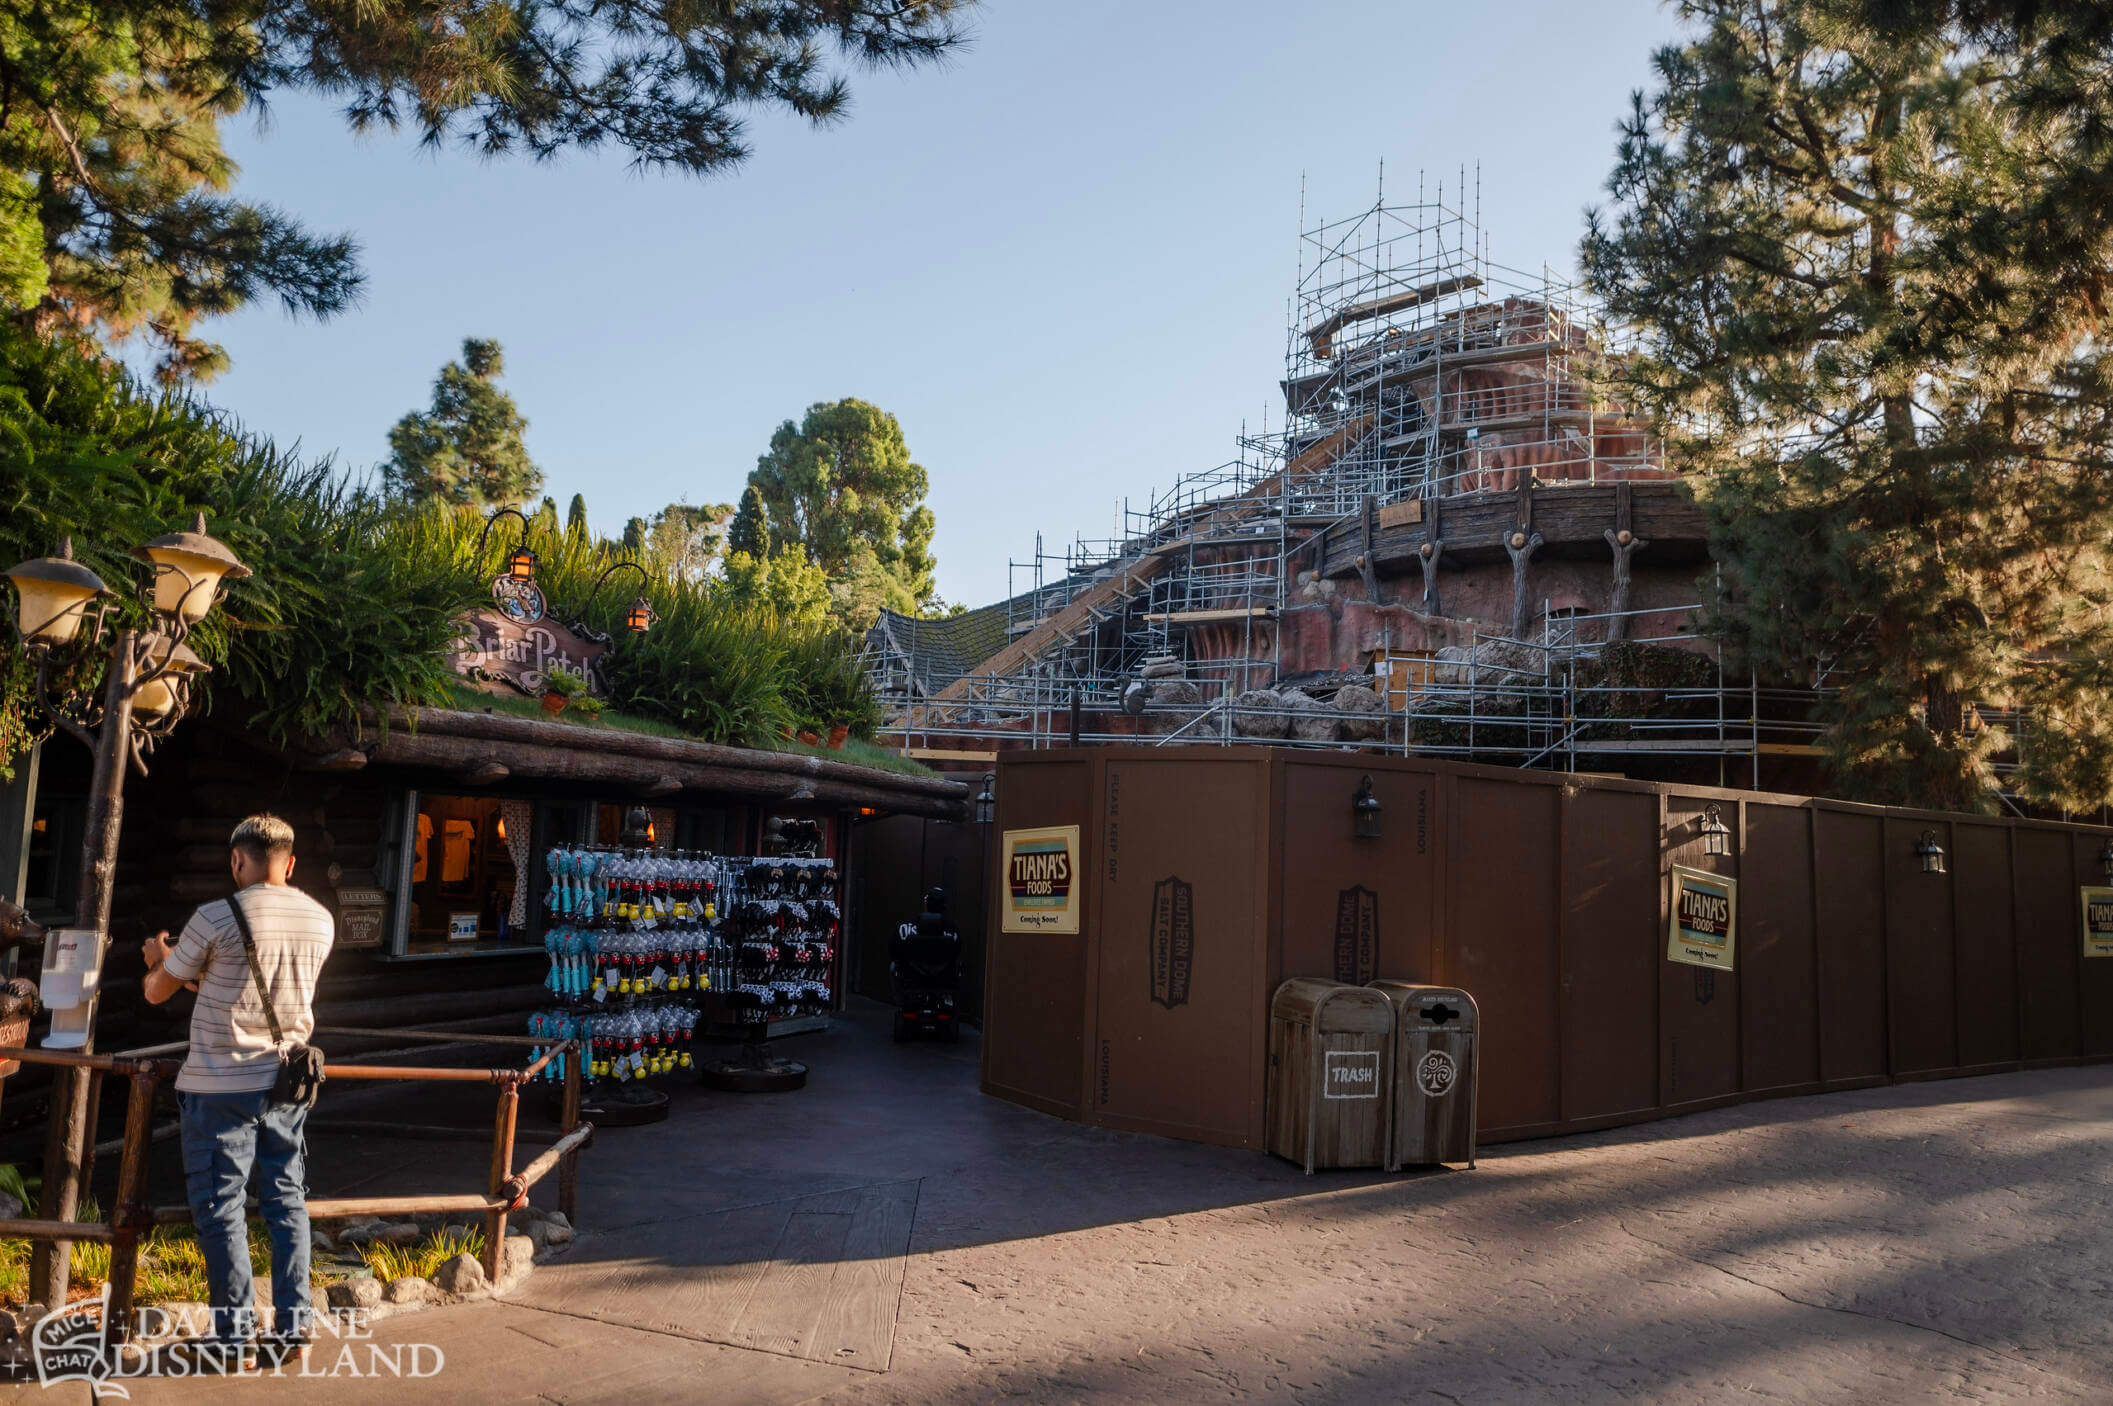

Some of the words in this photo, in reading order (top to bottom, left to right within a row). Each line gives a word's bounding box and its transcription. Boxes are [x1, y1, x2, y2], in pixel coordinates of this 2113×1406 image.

[455, 621, 532, 676] Briar
[520, 627, 600, 693] Patch
[1417, 789, 1426, 855] LOUISIANA
[1013, 853, 1068, 881] TIANA'S
[1027, 881, 1053, 895] FOODS
[1682, 890, 1727, 922] TIANA'S
[1159, 896, 1169, 926] SALT
[1175, 887, 1190, 957] SOUTHERN
[1340, 895, 1355, 935] DOME
[1693, 918, 1715, 933] FOODS
[1359, 904, 1370, 965] COMPANY
[1157, 929, 1169, 989] COMPANY
[1173, 960, 1188, 1000] DOME
[1101, 1039, 1111, 1105] LOUISIANA
[1331, 1067, 1373, 1083] TRASH
